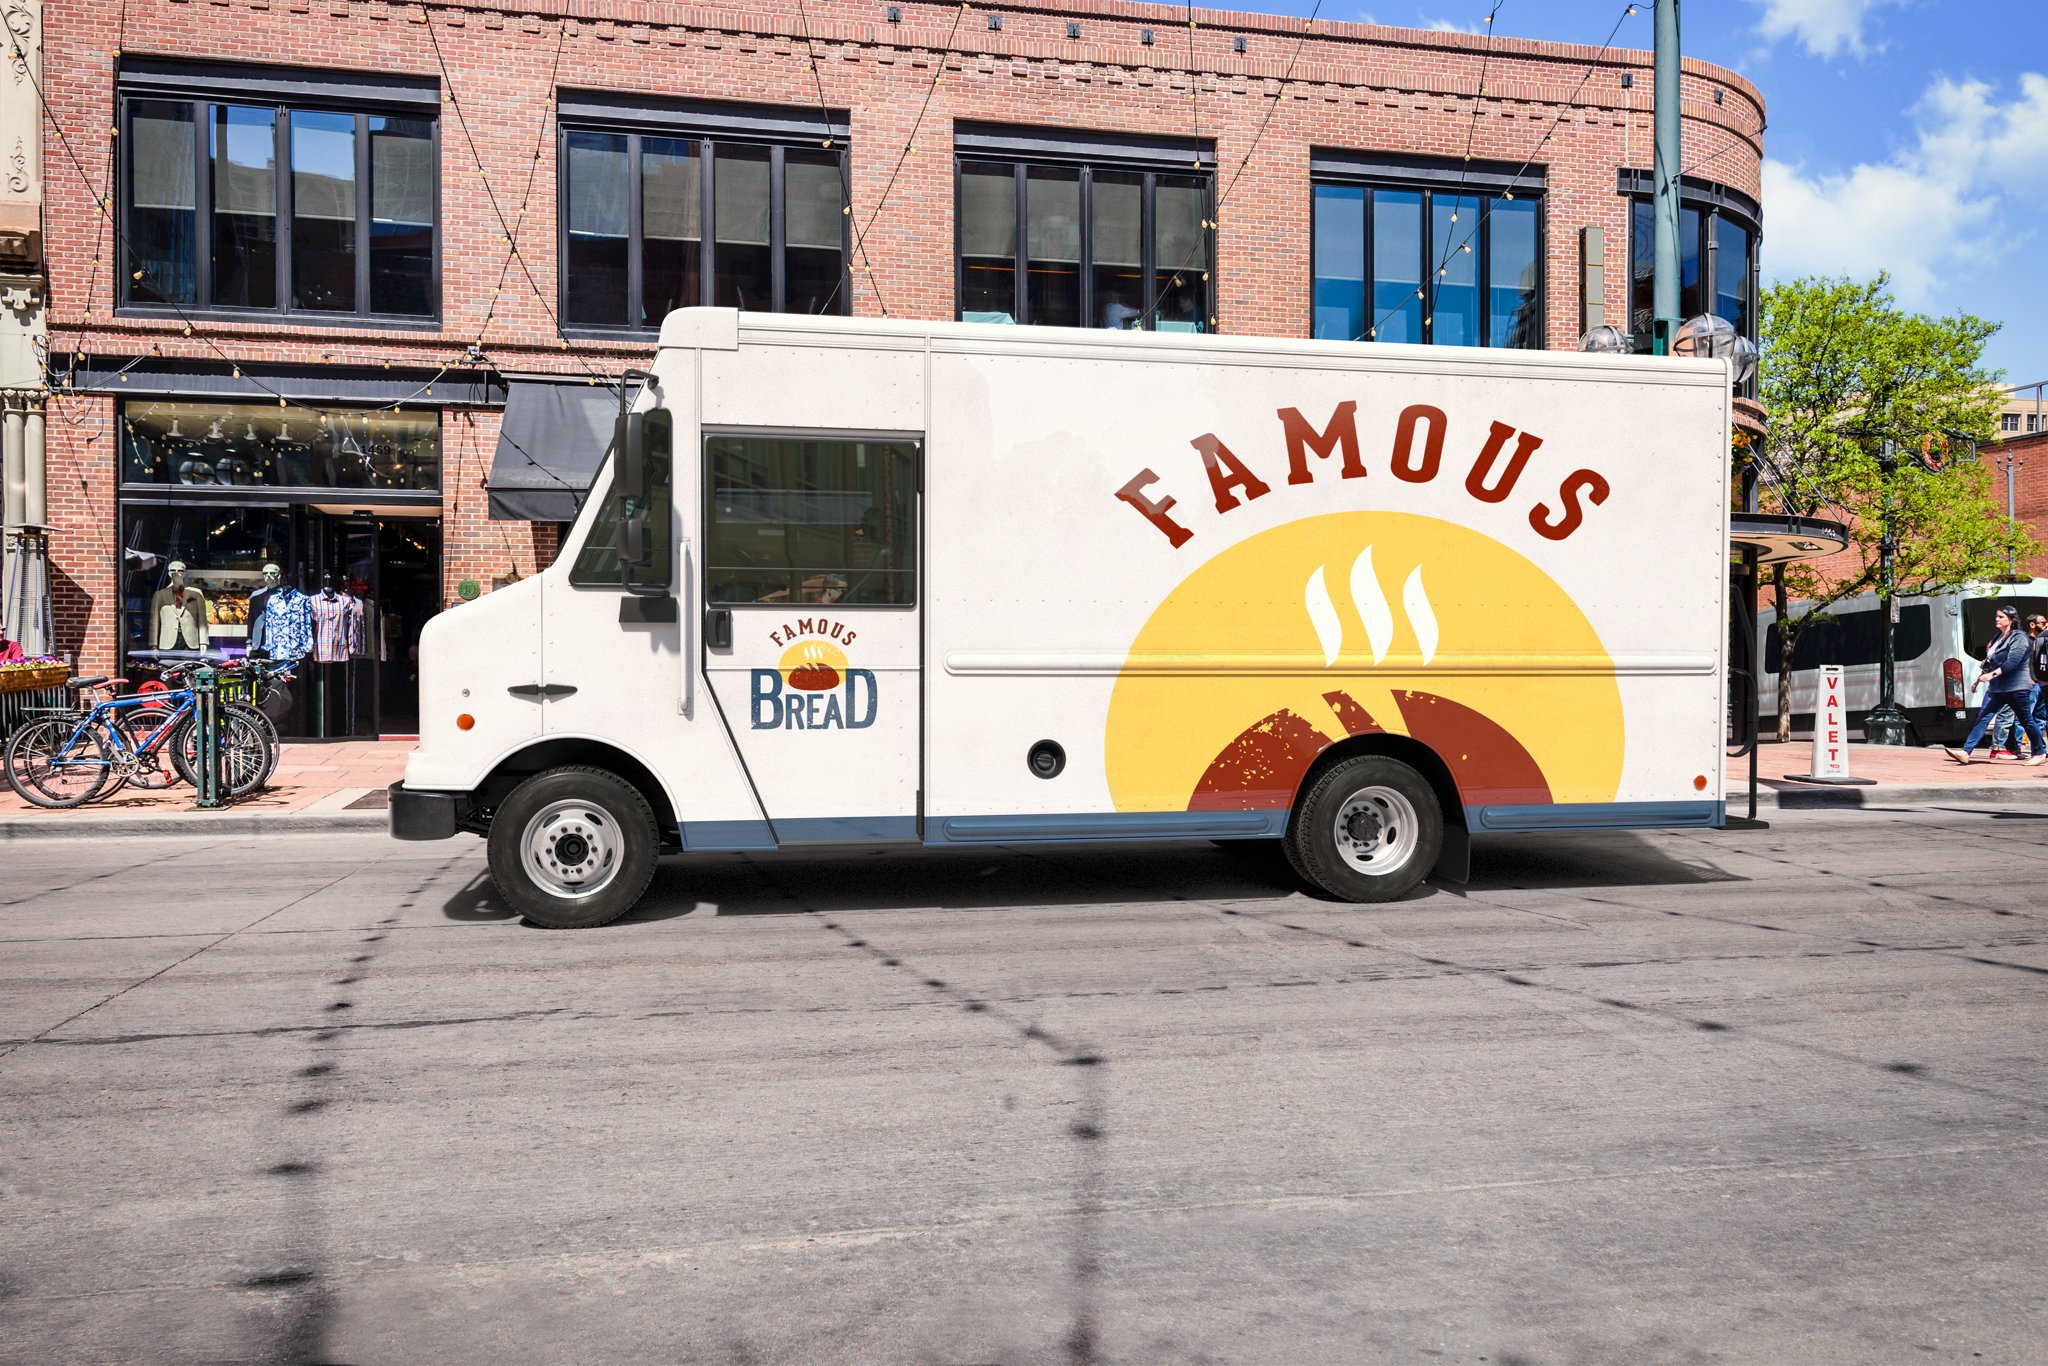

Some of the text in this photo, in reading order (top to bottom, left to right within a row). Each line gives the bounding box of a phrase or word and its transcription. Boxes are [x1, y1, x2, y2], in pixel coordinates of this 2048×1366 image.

[361, 445, 391, 455] 1459
[1114, 400, 1610, 549] FAMOUS
[769, 617, 857, 647] FAMOUS
[751, 668, 878, 730] BREAD
[1826, 677, 1839, 761] VALET
